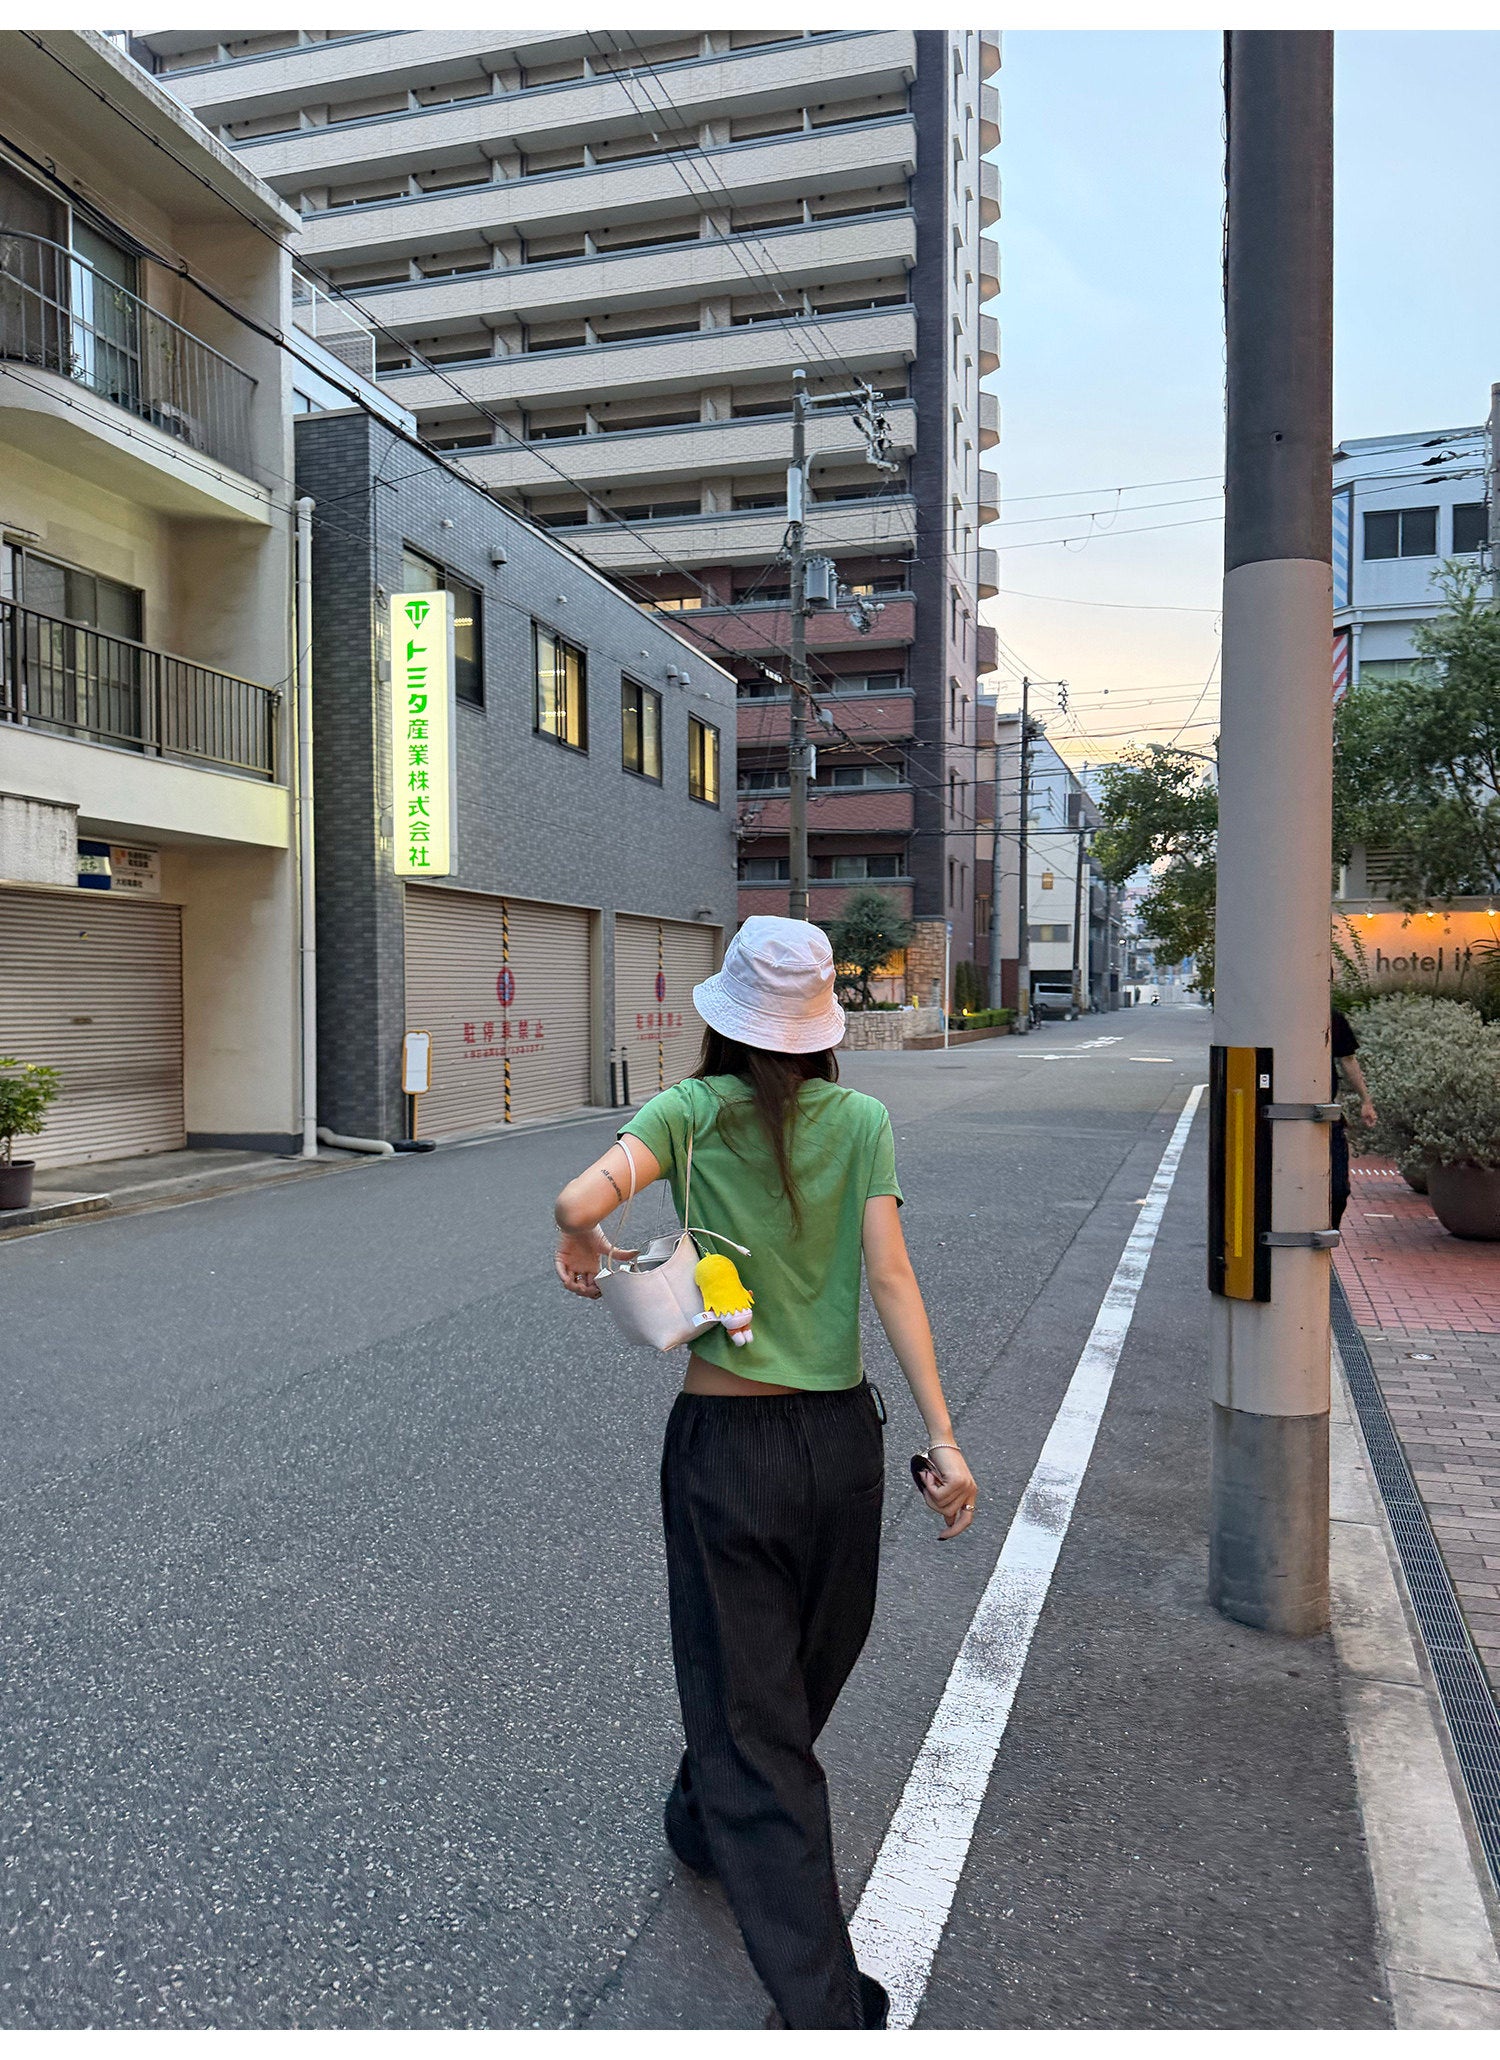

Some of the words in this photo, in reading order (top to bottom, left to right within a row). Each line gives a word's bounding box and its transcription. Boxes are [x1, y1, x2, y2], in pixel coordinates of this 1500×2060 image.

[407, 639, 430, 867] トミタ産業株式会社
[1376, 947, 1443, 972] hotel
